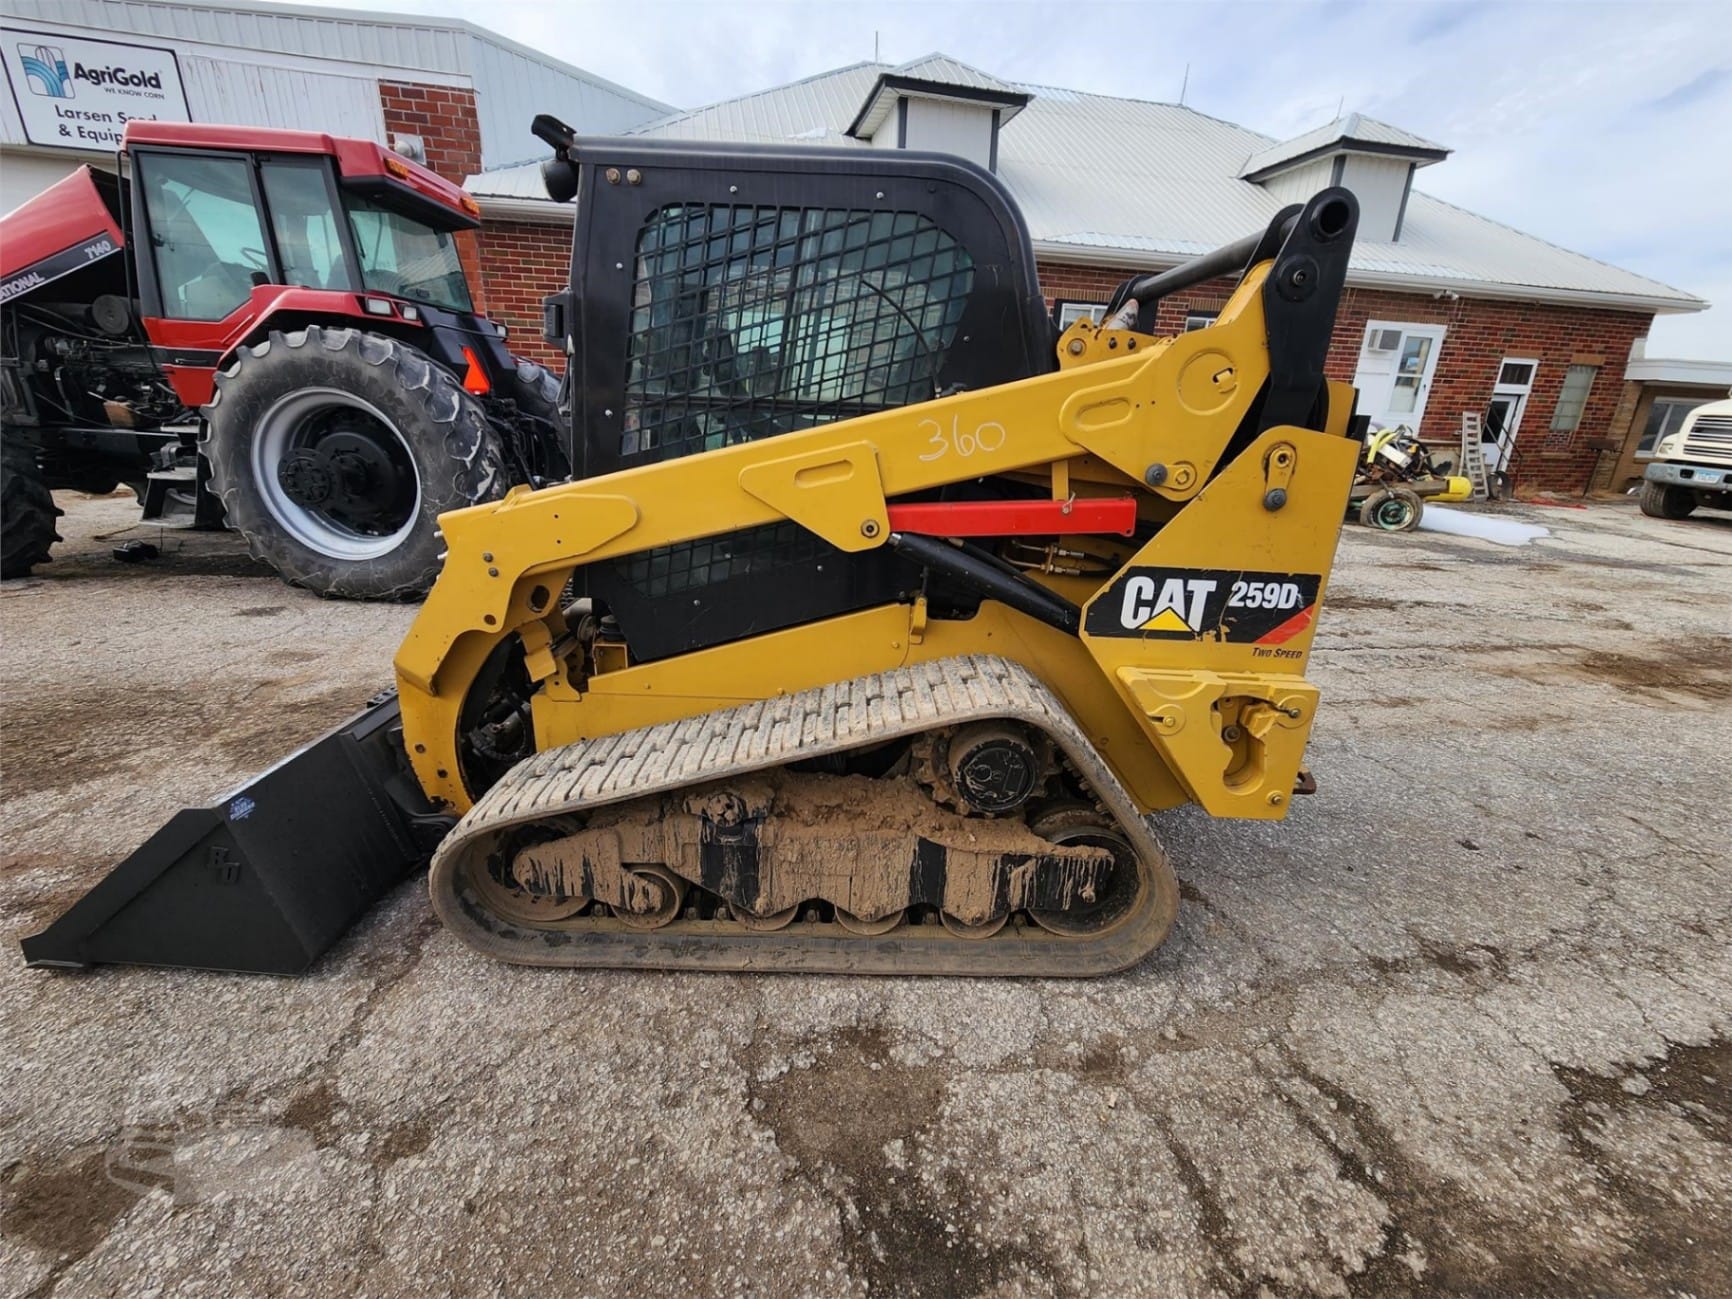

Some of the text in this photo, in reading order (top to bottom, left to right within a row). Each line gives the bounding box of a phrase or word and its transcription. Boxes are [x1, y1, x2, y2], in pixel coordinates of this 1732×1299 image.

[74, 62, 162, 89] AgriGold
[144, 91, 165, 99] CORN
[55, 104, 112, 123] Larsen
[59, 124, 72, 137] &
[918, 413, 1006, 462] 360
[1120, 575, 1300, 633] CAT 259D
